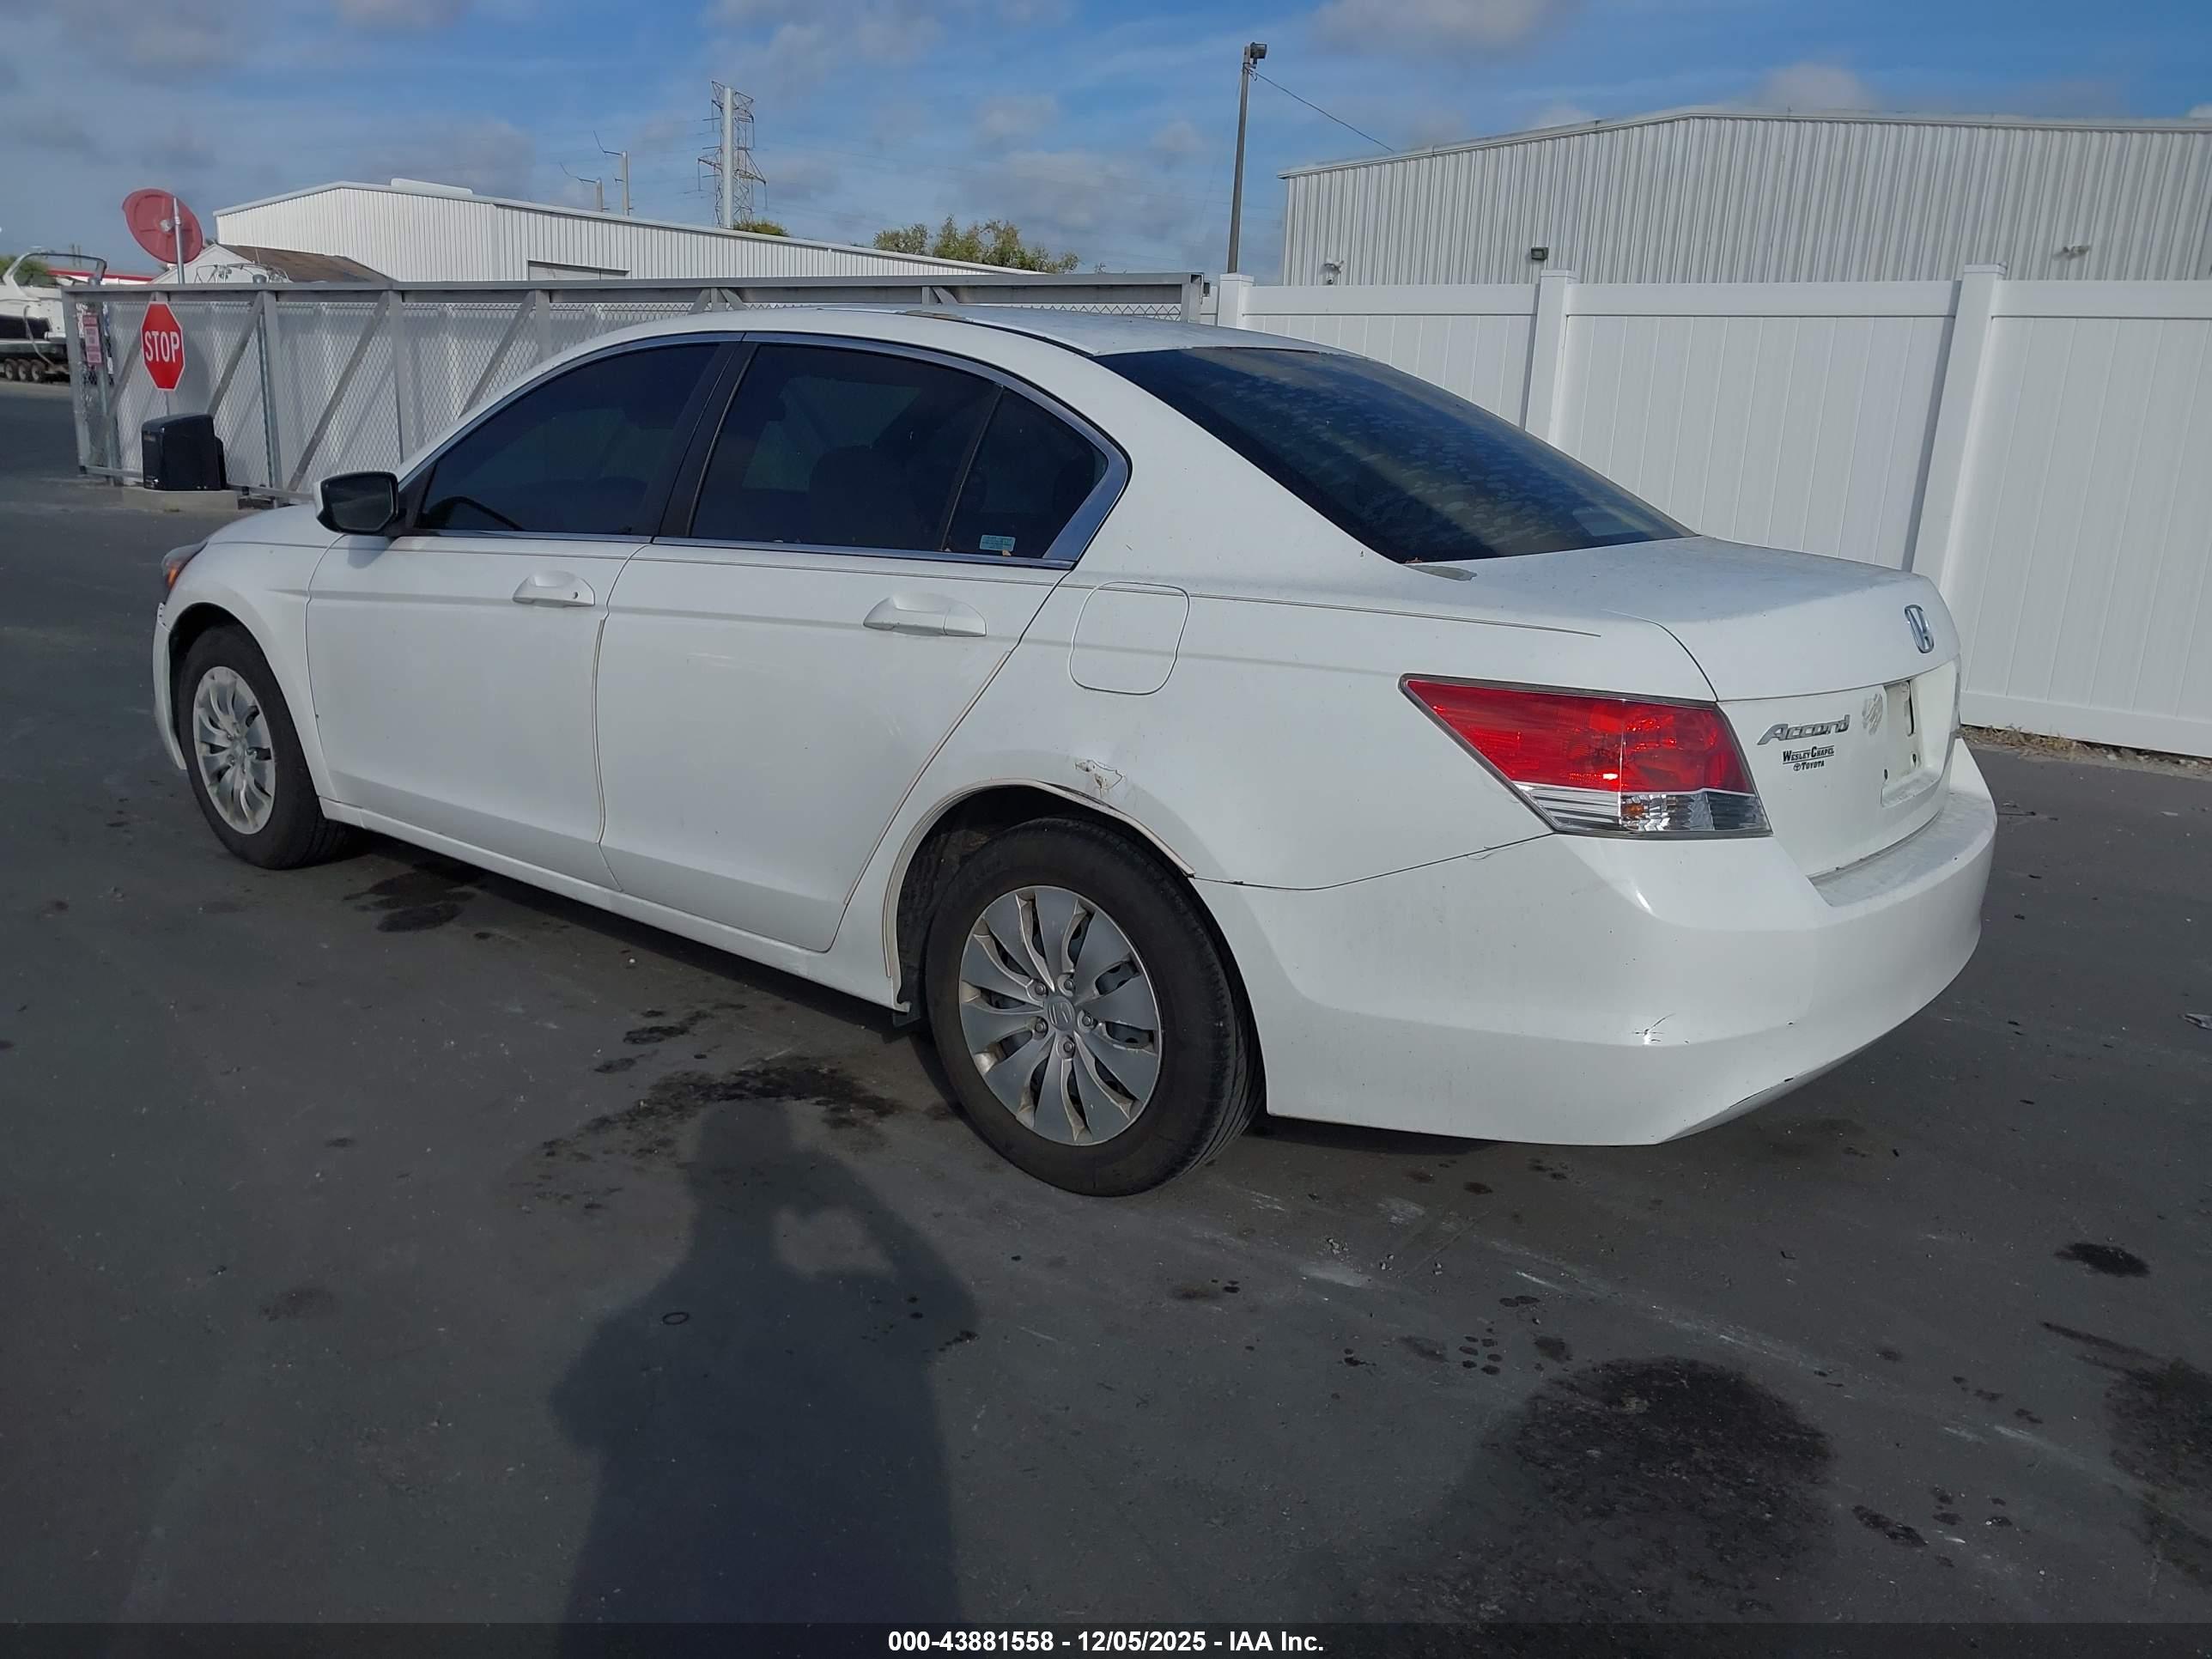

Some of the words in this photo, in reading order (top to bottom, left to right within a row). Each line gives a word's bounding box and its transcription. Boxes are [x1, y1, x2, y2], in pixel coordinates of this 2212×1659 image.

[144, 330, 180, 362] STOP
[1757, 714, 1850, 745] Accord
[1802, 761, 1825, 770] TOYOTA
